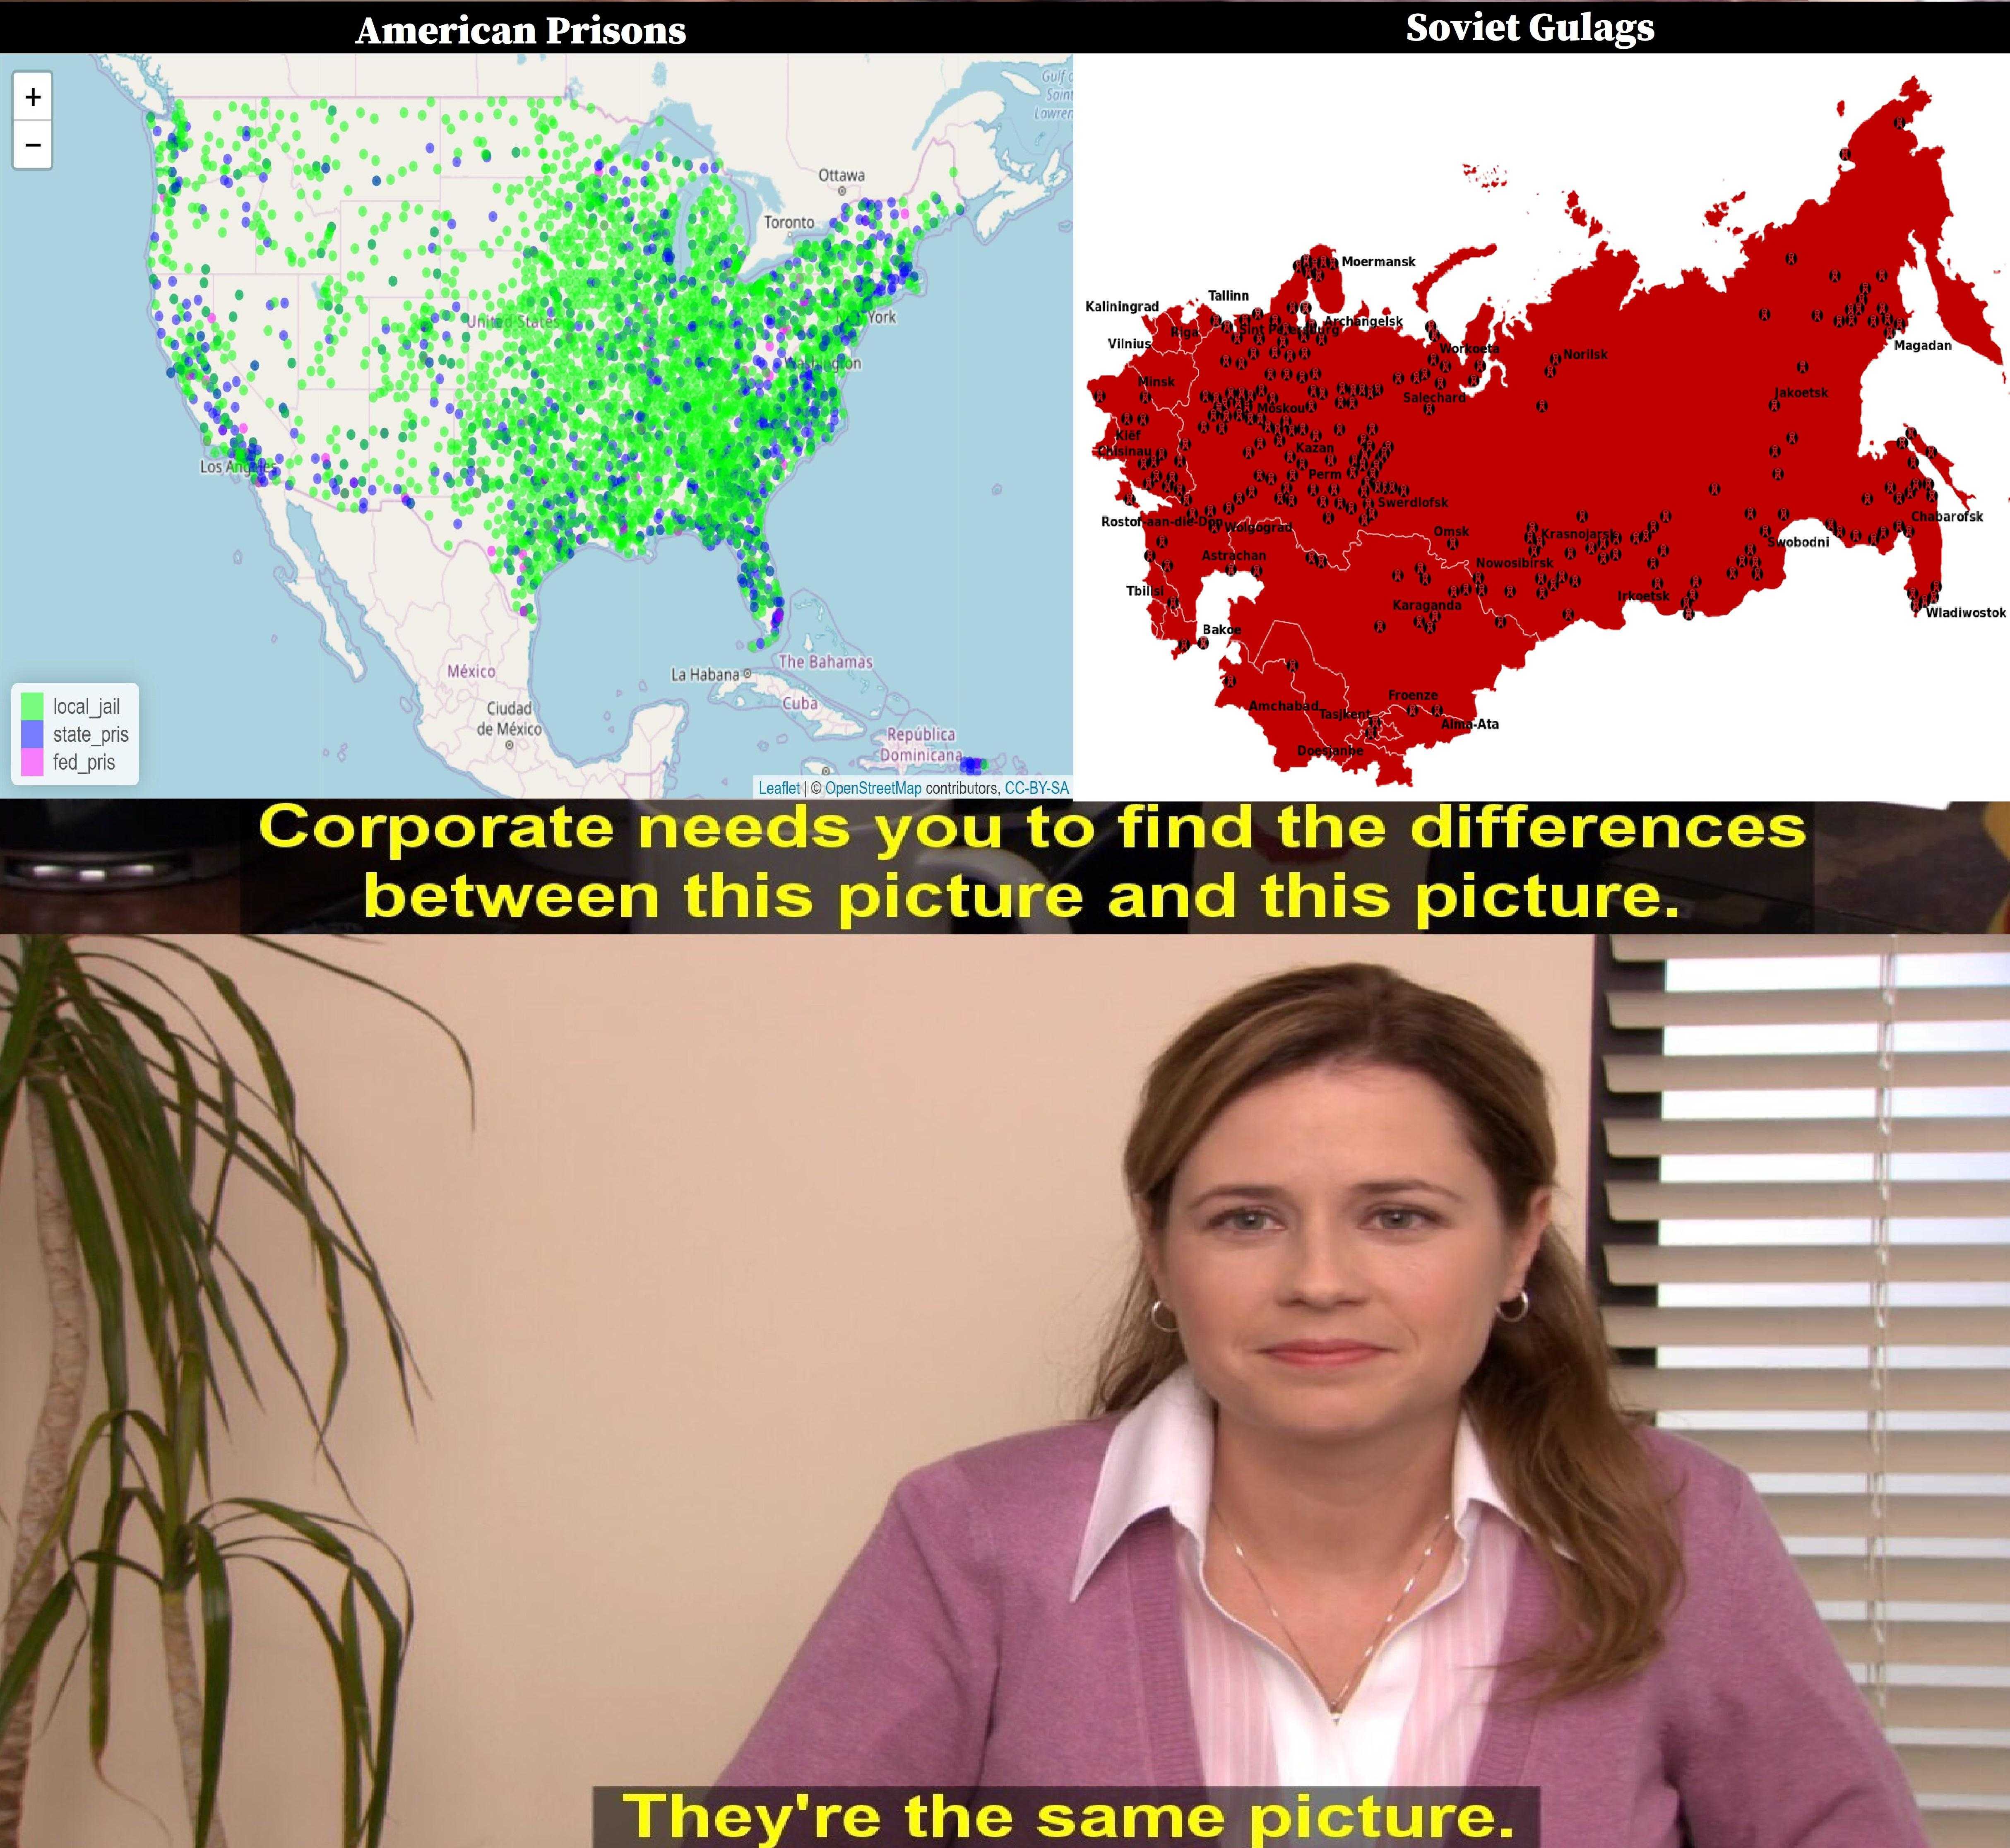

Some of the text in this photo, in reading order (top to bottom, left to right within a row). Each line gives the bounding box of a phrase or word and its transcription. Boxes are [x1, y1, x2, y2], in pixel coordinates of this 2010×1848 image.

[1043, 70, 1066, 85] Gulf
[819, 169, 865, 182] Ottawa
[765, 215, 814, 229] Toronto
[1342, 256, 1416, 267] Moermansk
[1209, 291, 1249, 301] Tallinn
[1086, 301, 1159, 314] Kaliningrad
[869, 310, 897, 325] York
[1325, 315, 1403, 328] Archangelsk
[1171, 327, 1199, 339] Riga
[1269, 324, 1339, 337] Peersburg
[1108, 338, 1151, 349] Vilnius
[1440, 343, 1500, 354] Workoeta
[1894, 340, 1952, 353] Magadan
[1564, 349, 1608, 360] Norilsk
[1138, 377, 1175, 388] Minsk
[1404, 392, 1466, 403] Salechard
[1774, 387, 1829, 400] Jakoetsk
[1257, 402, 1305, 414] Moskou
[1296, 443, 1334, 454] Kazan
[201, 460, 277, 478] Los Angles
[1309, 469, 1342, 480] Perm
[1378, 496, 1449, 508] Swerdlofsk
[1911, 511, 1984, 522] Chabarofsk
[1225, 521, 1293, 534] Wolgograd
[1433, 526, 1470, 537] Omsk
[1767, 537, 1830, 549] Swobodni
[1202, 550, 1267, 561] Astrachan
[1476, 557, 1555, 568] Nowosibirsk
[1126, 585, 1164, 597] Tbilisi
[1618, 591, 1670, 602] Irkoetsk
[1392, 600, 1462, 614] Karaganda
[1926, 607, 2007, 618] Wladiwostok
[1203, 624, 1242, 636] Bakoe
[780, 654, 873, 668] The Bahamas
[448, 664, 496, 678] México
[672, 667, 739, 681] La Habana
[1388, 690, 1438, 701] Froenze
[54, 698, 120, 718] local_jail
[488, 701, 531, 715] Ciudad
[783, 696, 818, 710] Cuba
[1249, 700, 1319, 712] Amchabad
[1320, 708, 1371, 721] Tasjkent
[477, 722, 542, 736] de México
[1441, 719, 1500, 730] Alma-Ata
[53, 725, 129, 746] state_pris
[888, 726, 955, 744] República
[880, 748, 963, 762] Dominicana
[1298, 745, 1364, 758] Doesjanbe
[53, 753, 115, 774] fed_pris
[759, 781, 800, 794] Leaflet
[825, 781, 922, 798] OpenStreetMap
[926, 781, 1000, 797] contributors,
[1005, 781, 1070, 794] CC-BY-SA
